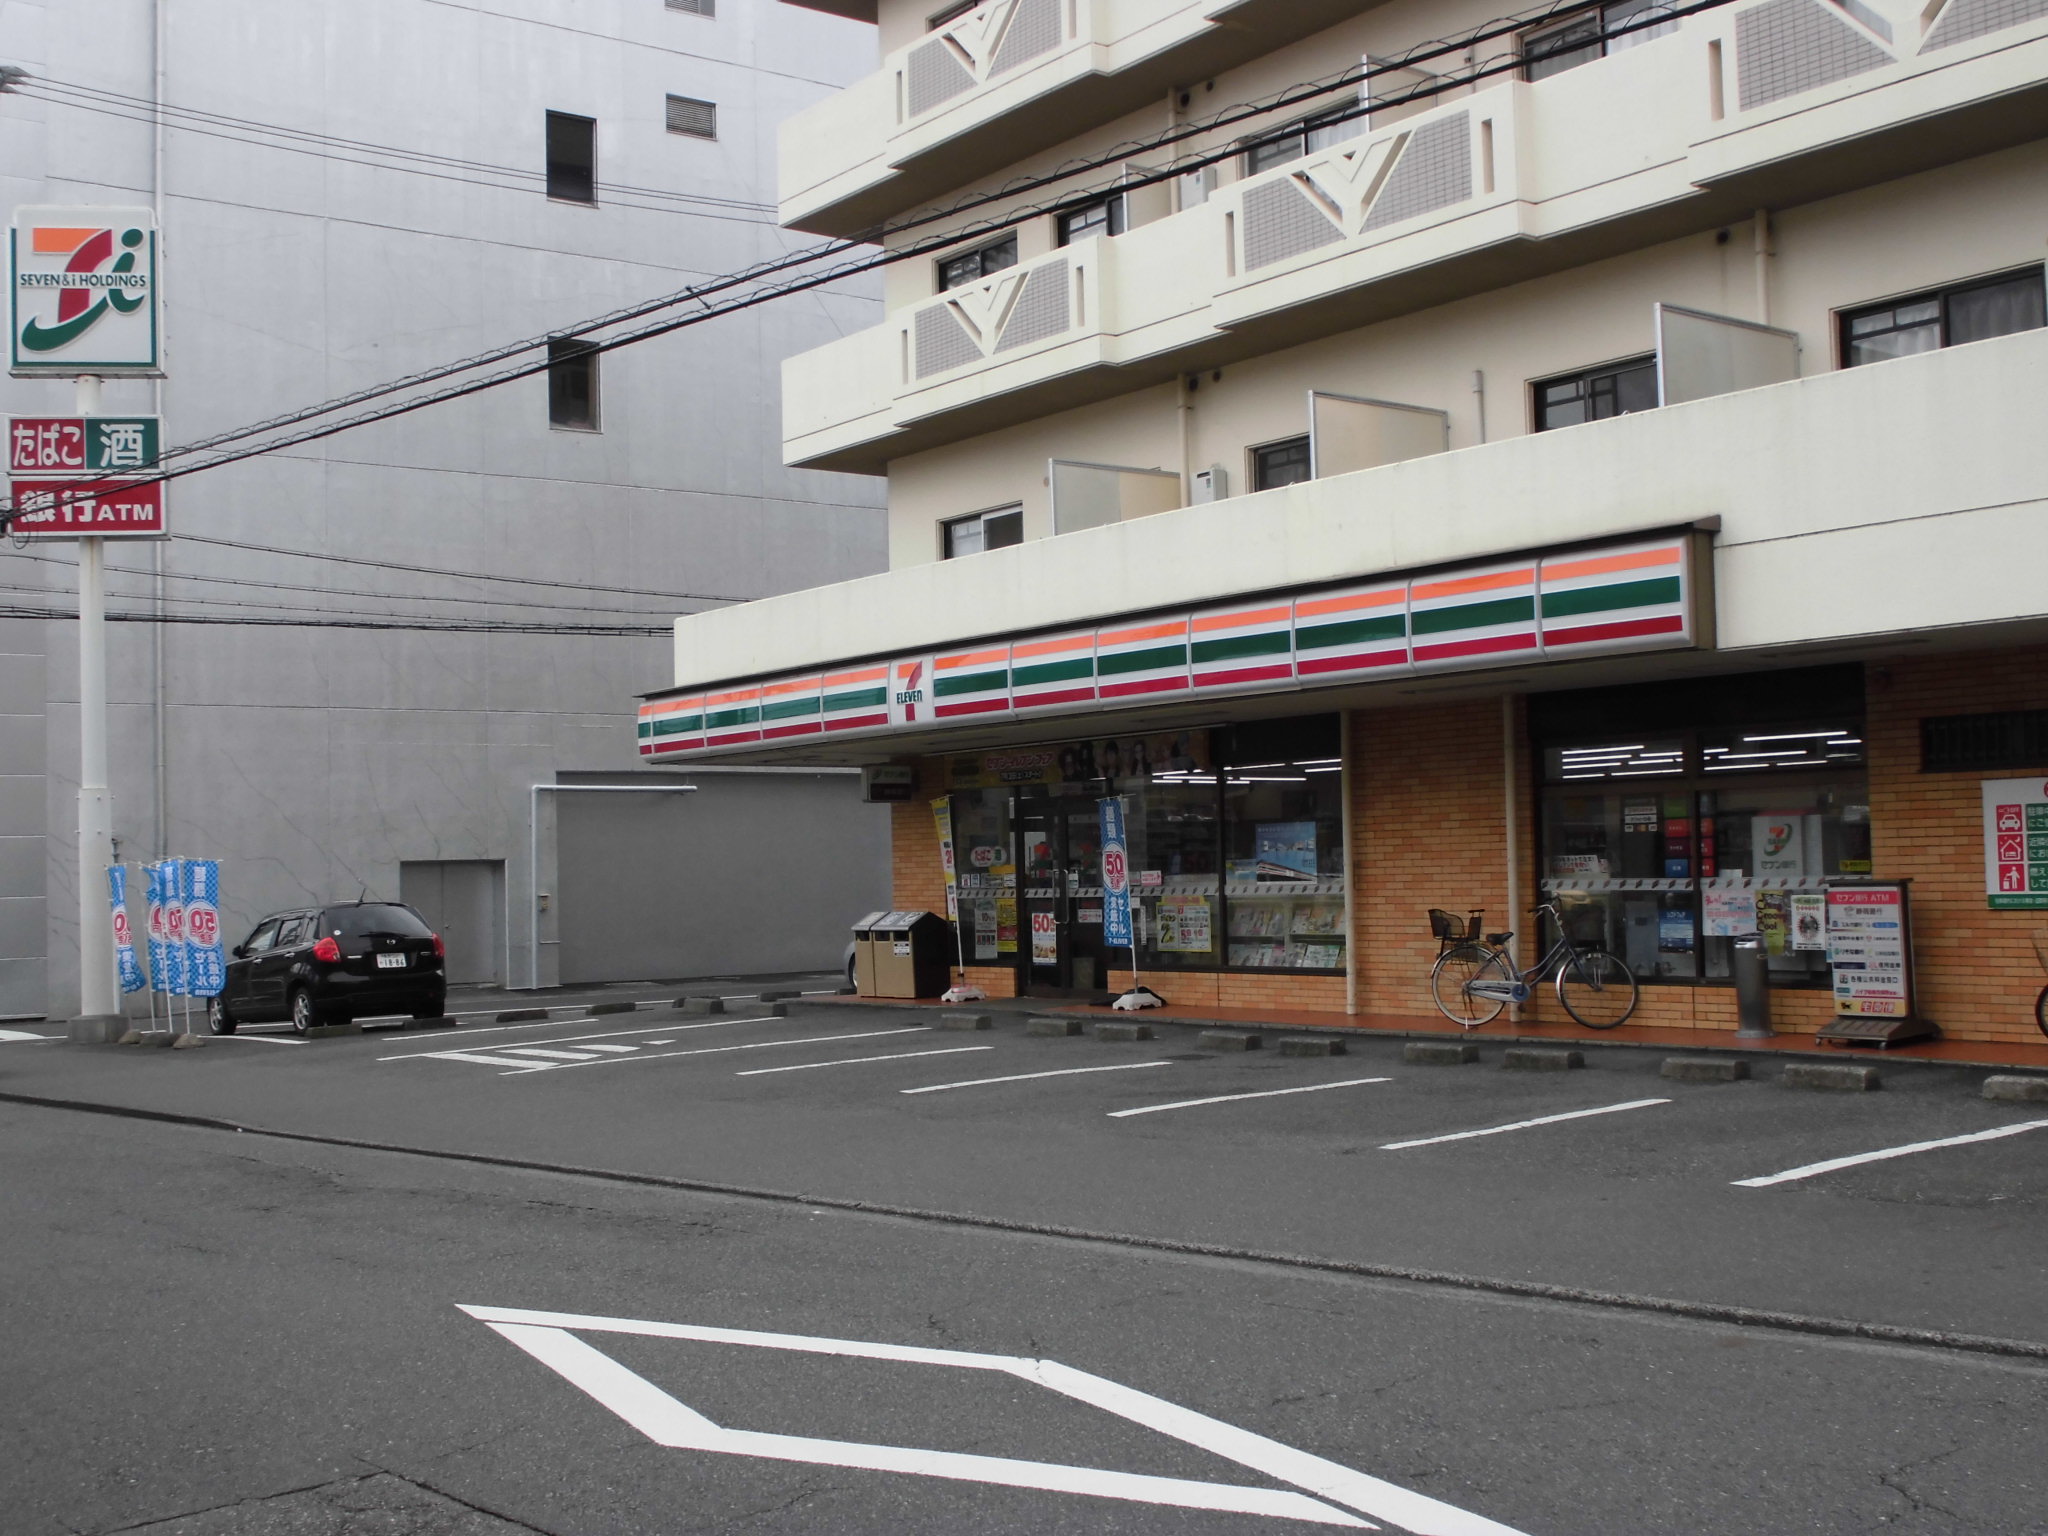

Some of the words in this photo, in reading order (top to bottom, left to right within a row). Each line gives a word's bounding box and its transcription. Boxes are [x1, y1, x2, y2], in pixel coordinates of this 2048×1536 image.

[79, 275, 147, 287] HOLDINGS
[14, 423, 82, 466] たばこ
[100, 423, 145, 467] 酒
[896, 689, 923, 704] ELEVEN
[1105, 853, 1125, 875] 50
[1870, 893, 1890, 902] ATM
